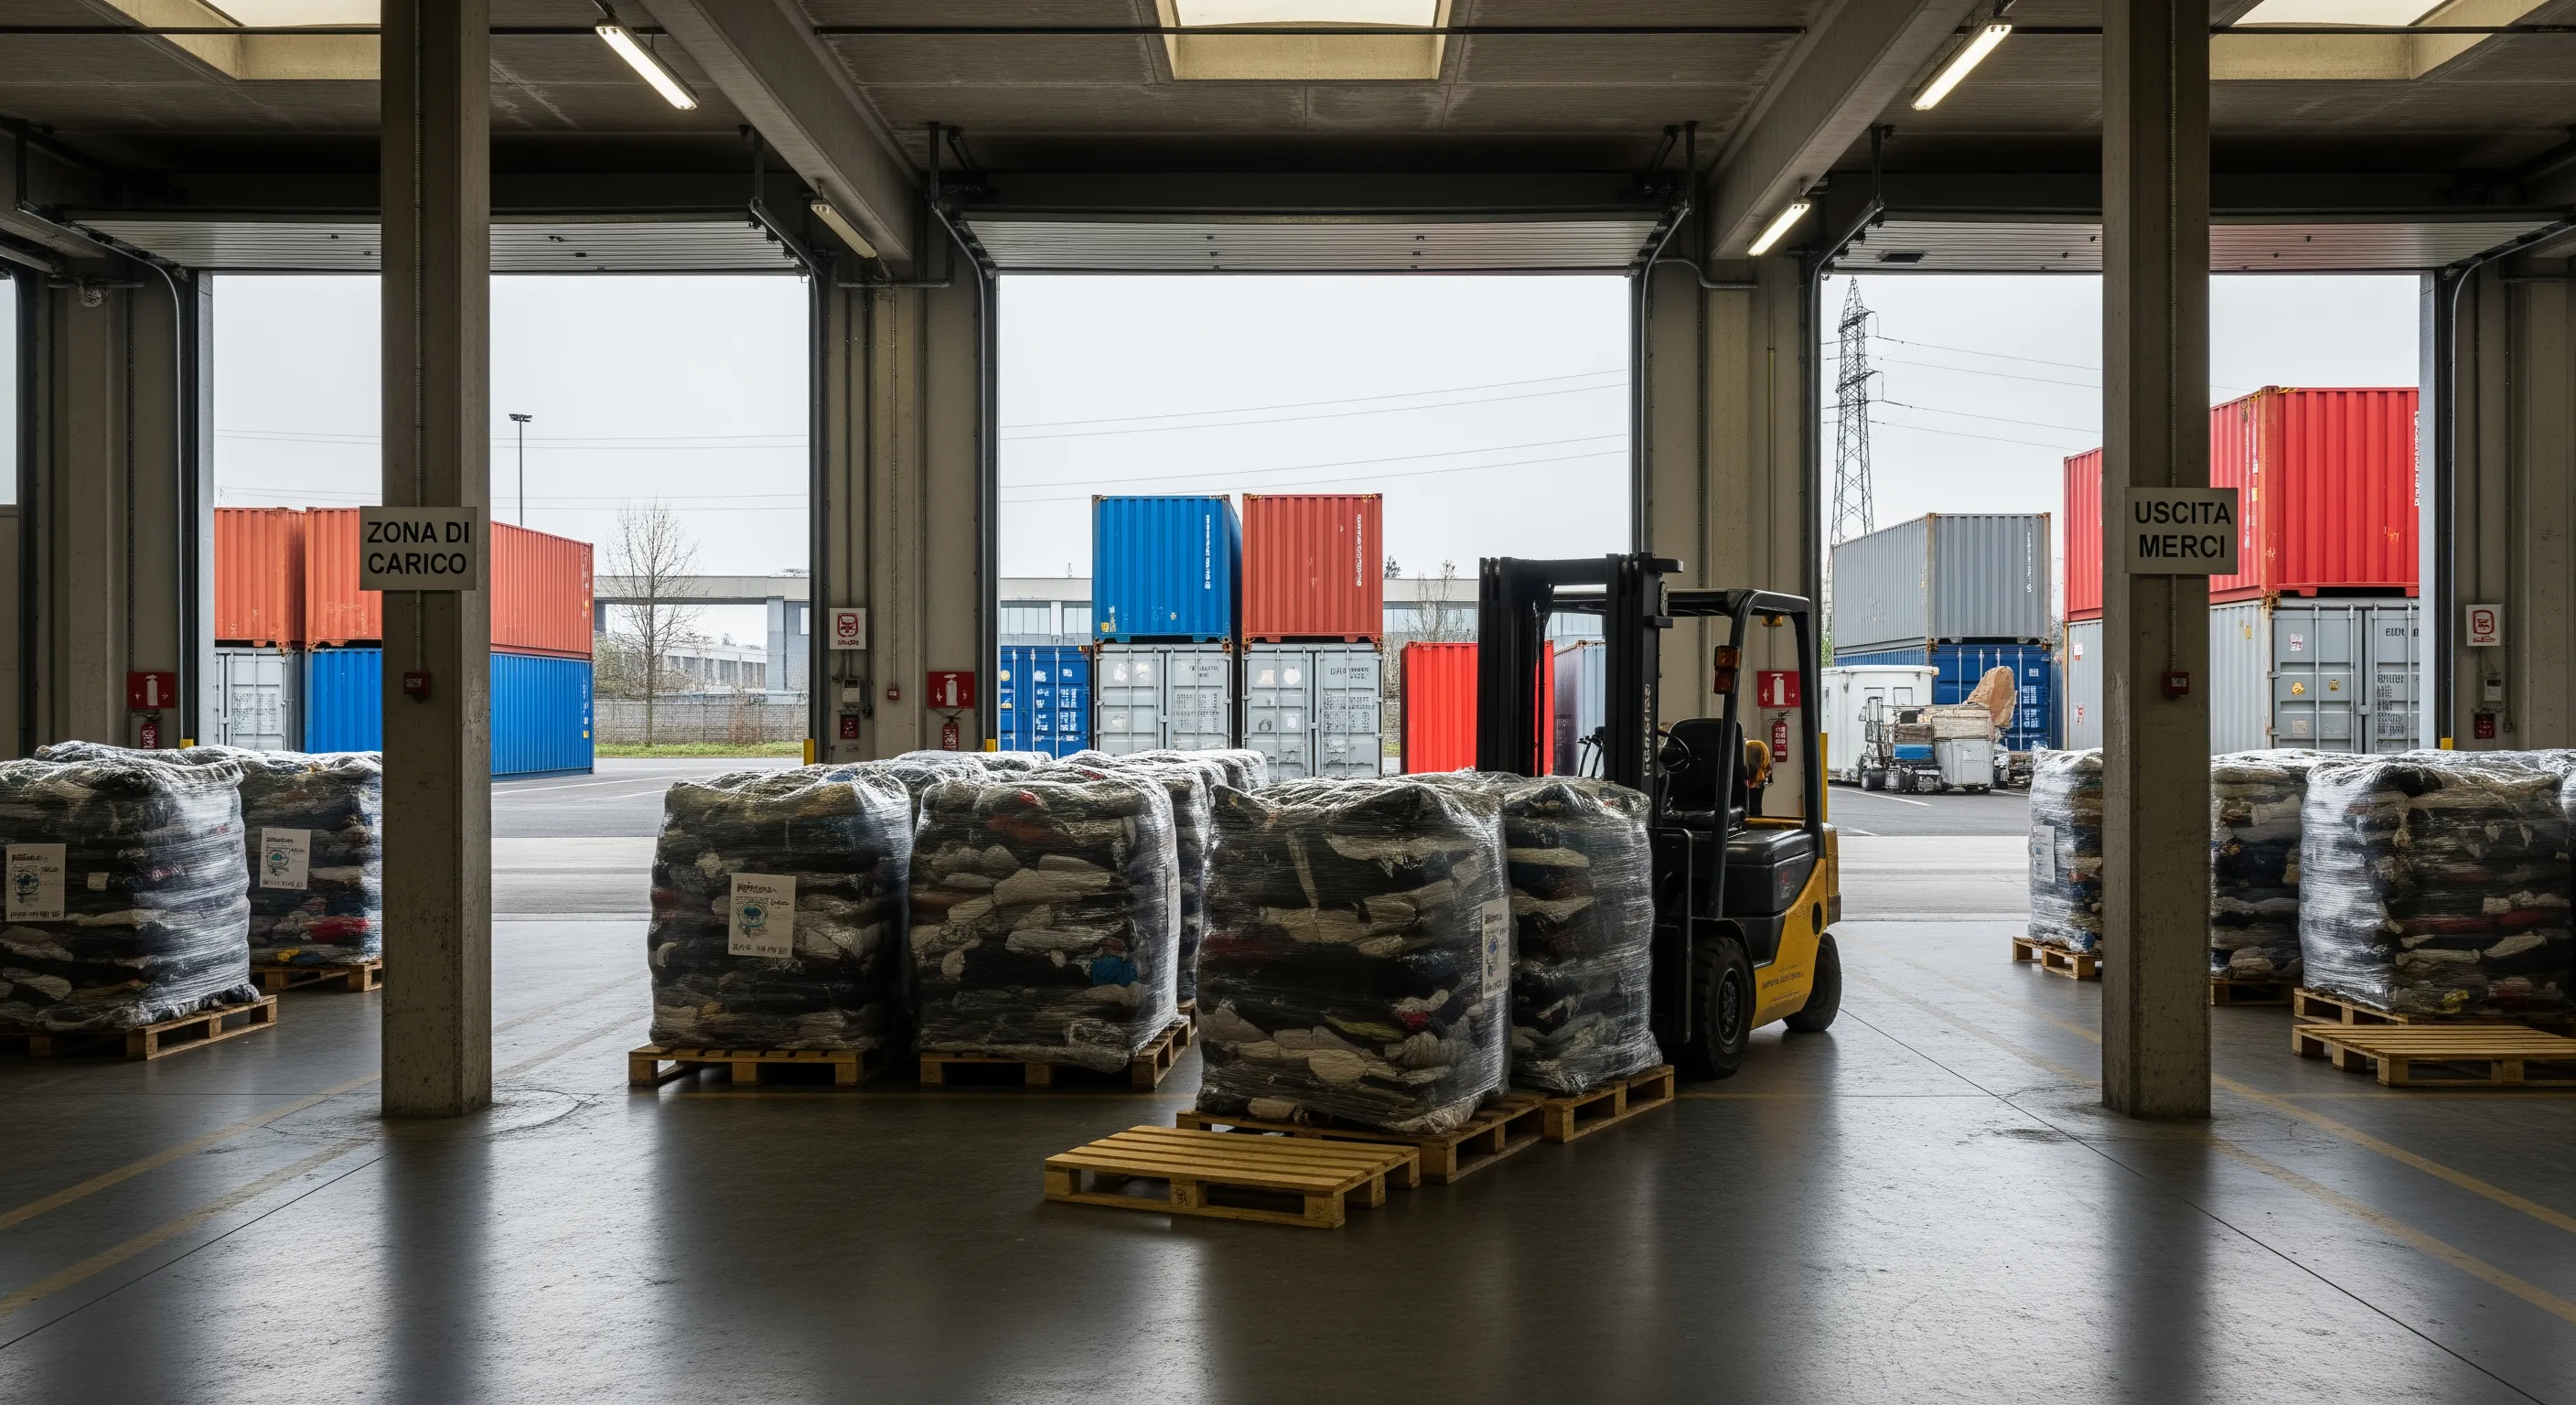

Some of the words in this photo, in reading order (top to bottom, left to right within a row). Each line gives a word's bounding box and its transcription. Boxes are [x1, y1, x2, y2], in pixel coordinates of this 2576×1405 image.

[2134, 500, 2232, 525] USCITA
[367, 521, 438, 543] ZONA
[445, 521, 469, 543] DI
[2139, 534, 2225, 558] MERCI
[368, 552, 467, 575] CARICO
